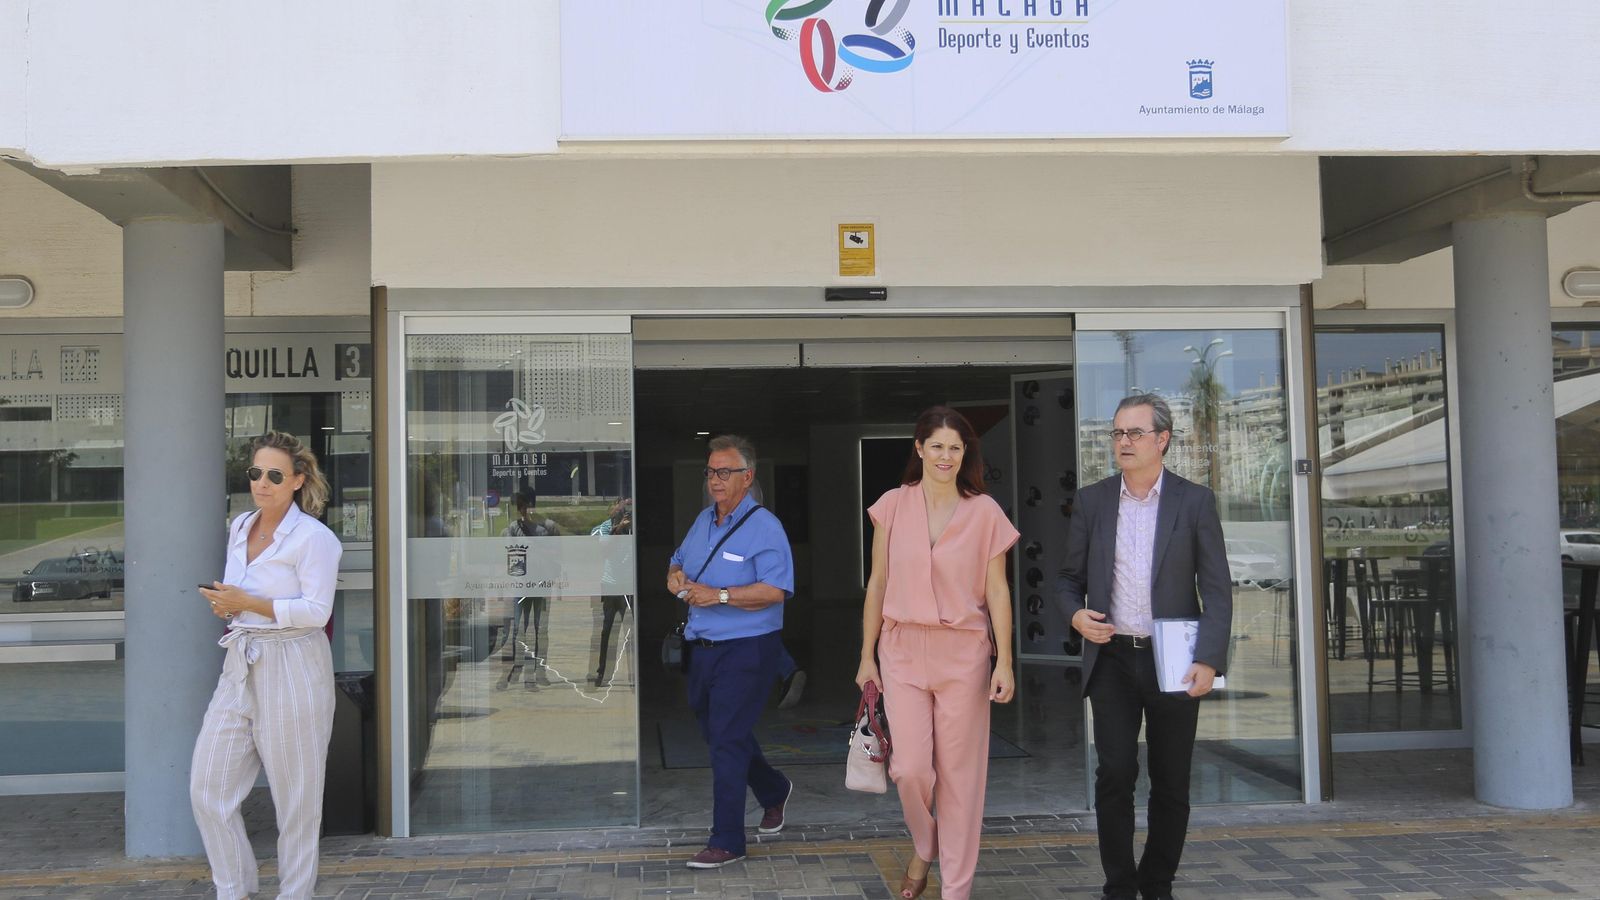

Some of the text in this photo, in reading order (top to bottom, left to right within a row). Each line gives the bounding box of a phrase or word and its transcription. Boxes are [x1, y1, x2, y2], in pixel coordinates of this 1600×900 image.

[938, 27, 1089, 54] Deporte y Eventos
[1139, 105, 1265, 116] Ayuntamiento de Málaga
[226, 345, 360, 378] QUILLA 3
[492, 451, 546, 465] MÁLAGA
[492, 468, 515, 478] Deporte
[518, 469, 521, 478] y
